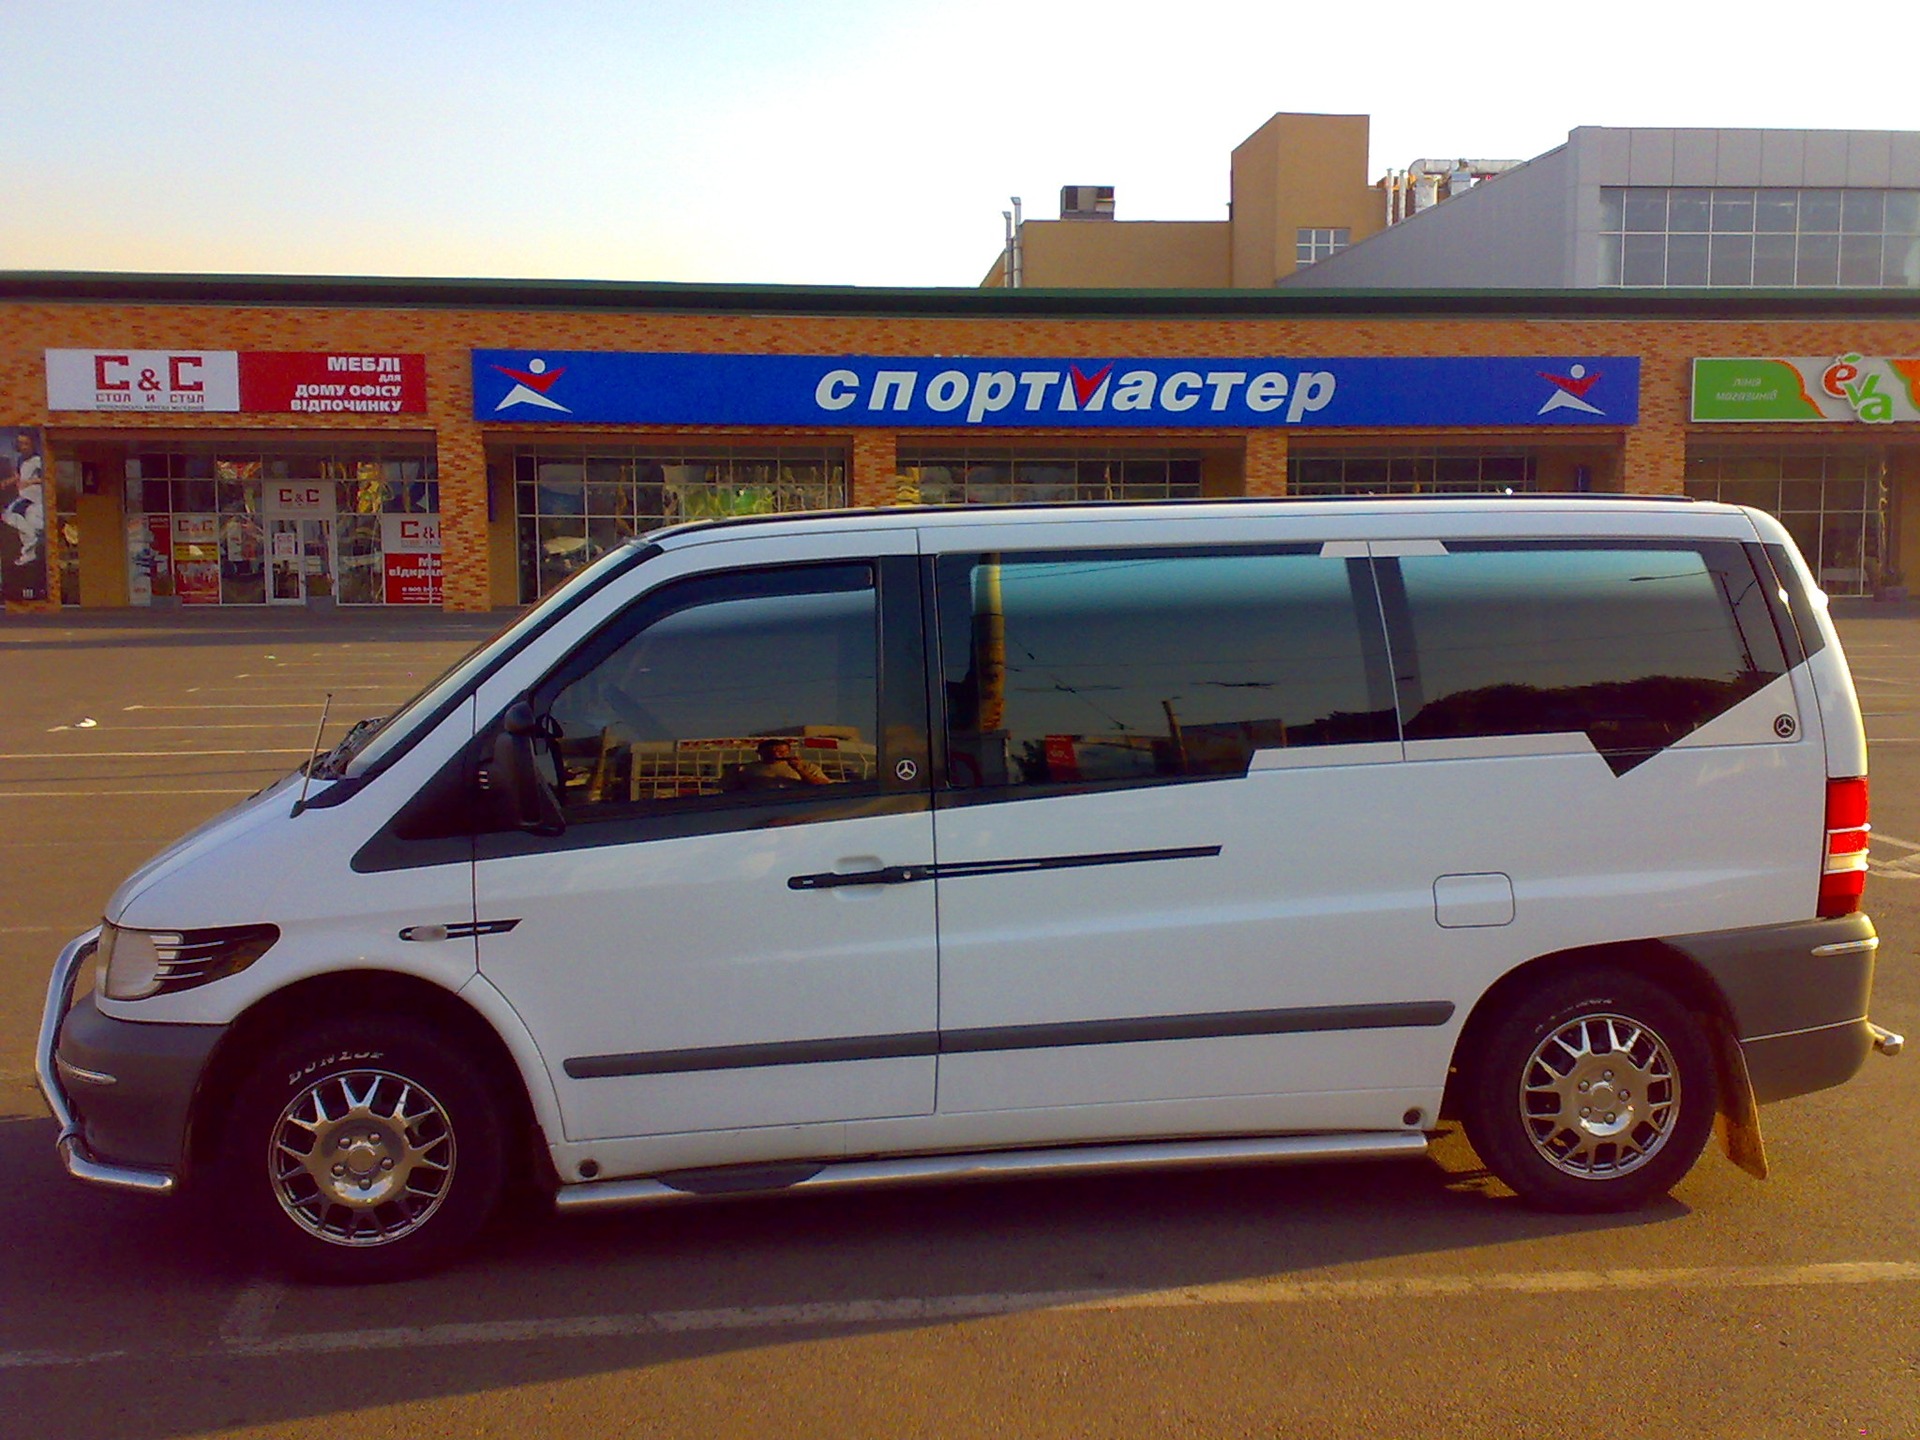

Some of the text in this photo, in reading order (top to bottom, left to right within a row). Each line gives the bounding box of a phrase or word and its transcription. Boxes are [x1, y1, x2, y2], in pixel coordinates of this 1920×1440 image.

[327, 356, 400, 372] МЕБЛІ
[295, 384, 401, 397] ДОМУ ОФІСУ
[96, 393, 204, 403] СТОЛ И СТУЛ
[290, 400, 402, 412] ВІДПОЧИНКУ
